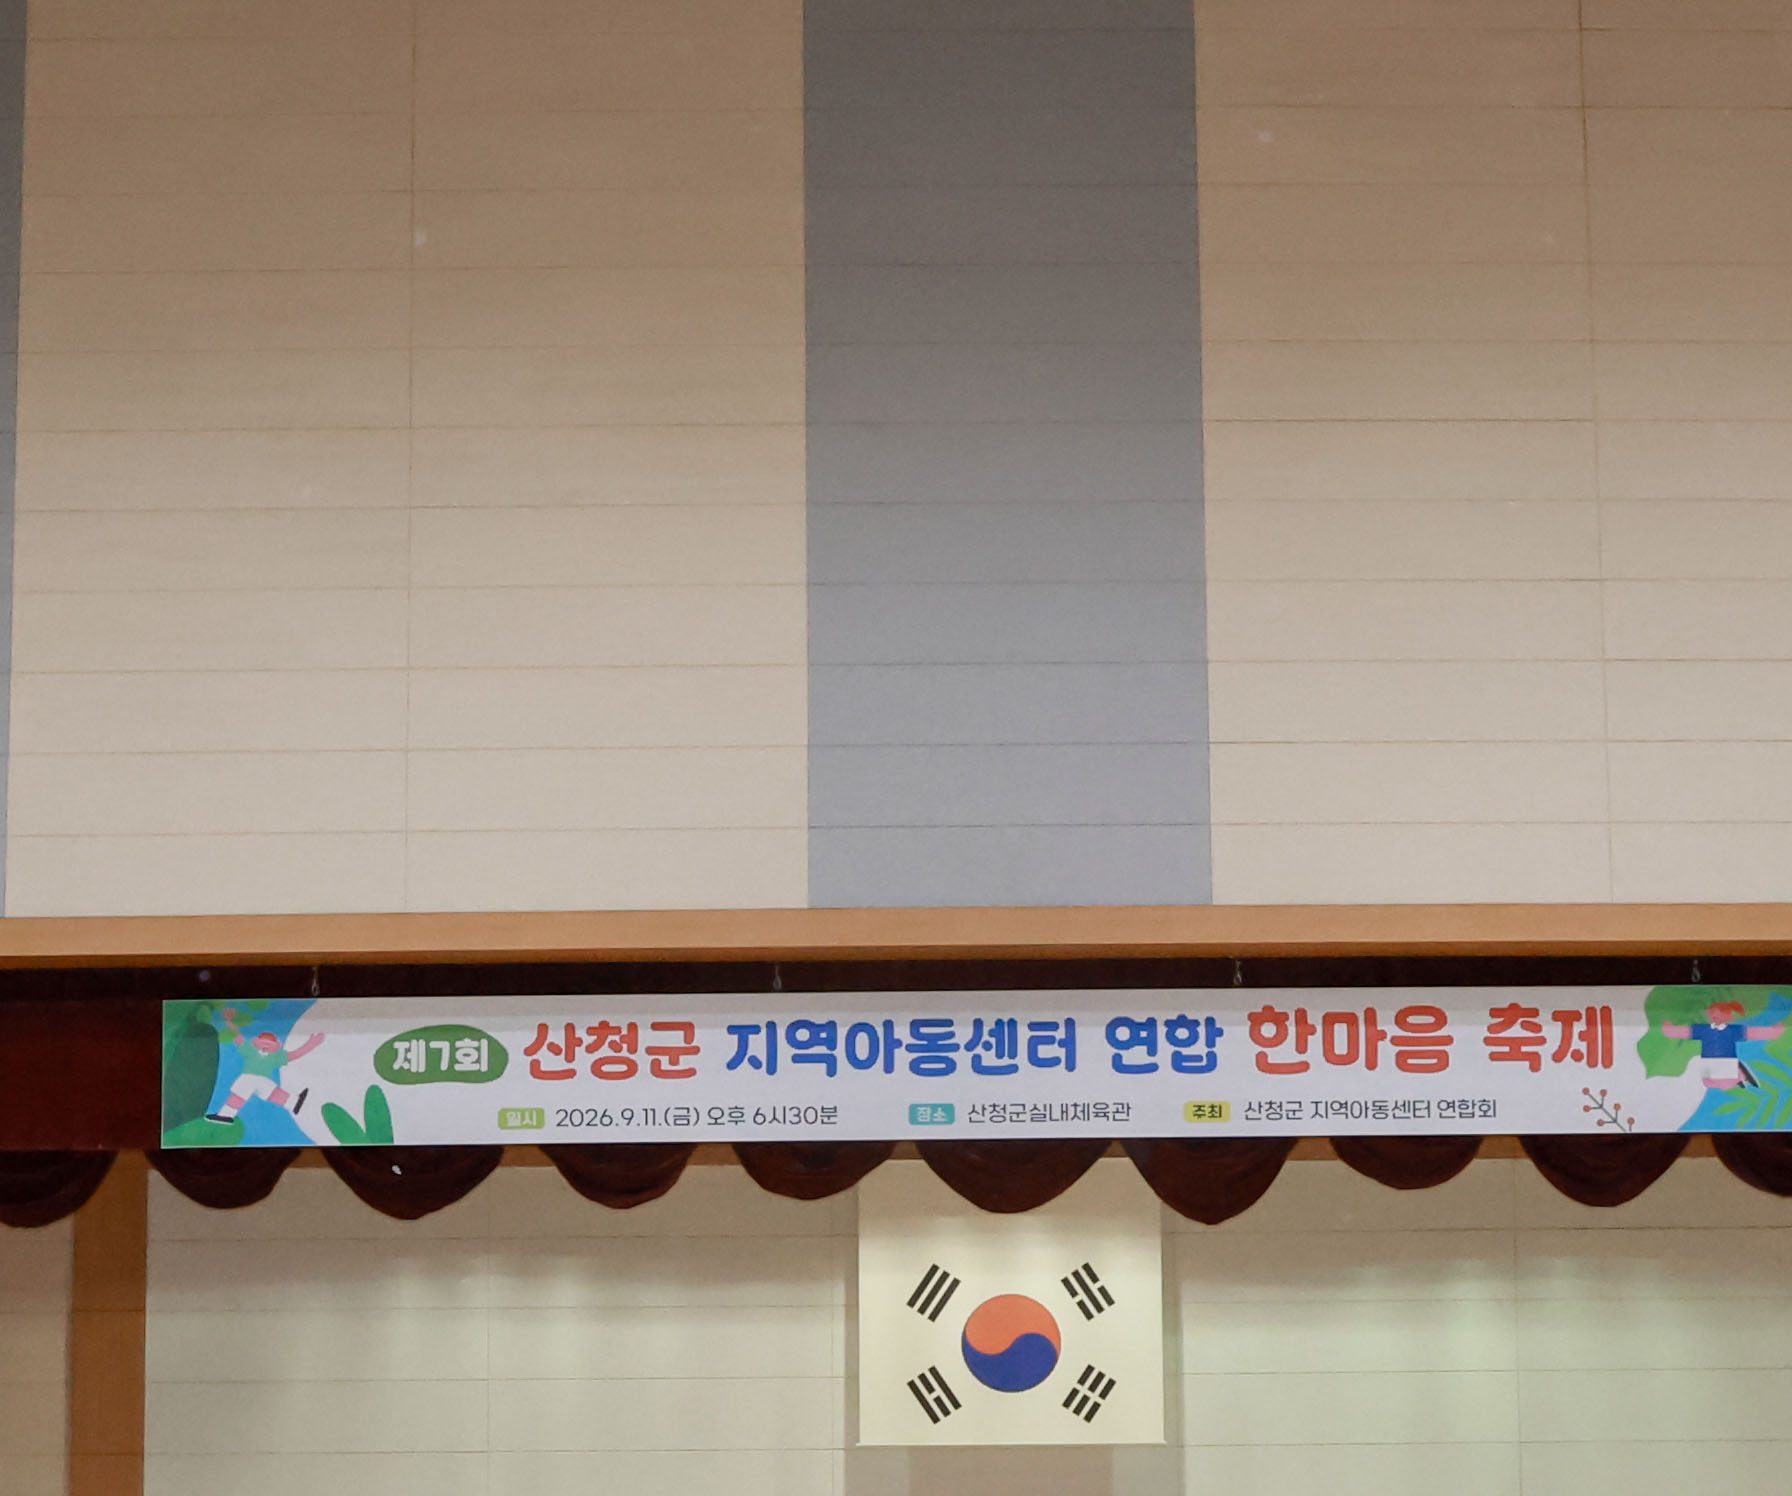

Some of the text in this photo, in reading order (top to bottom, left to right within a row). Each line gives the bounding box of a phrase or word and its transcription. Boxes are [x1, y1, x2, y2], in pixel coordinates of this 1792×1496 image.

[392, 1002, 1614, 1081] 제7회 산청군 지역아동센터 연합 한마음 축제
[505, 1098, 1497, 1128] 일시 2026.9.11.(금) 오후 6시30분 장소 산청군실내체육관 주최 산청군 지역아동센터 연합회
